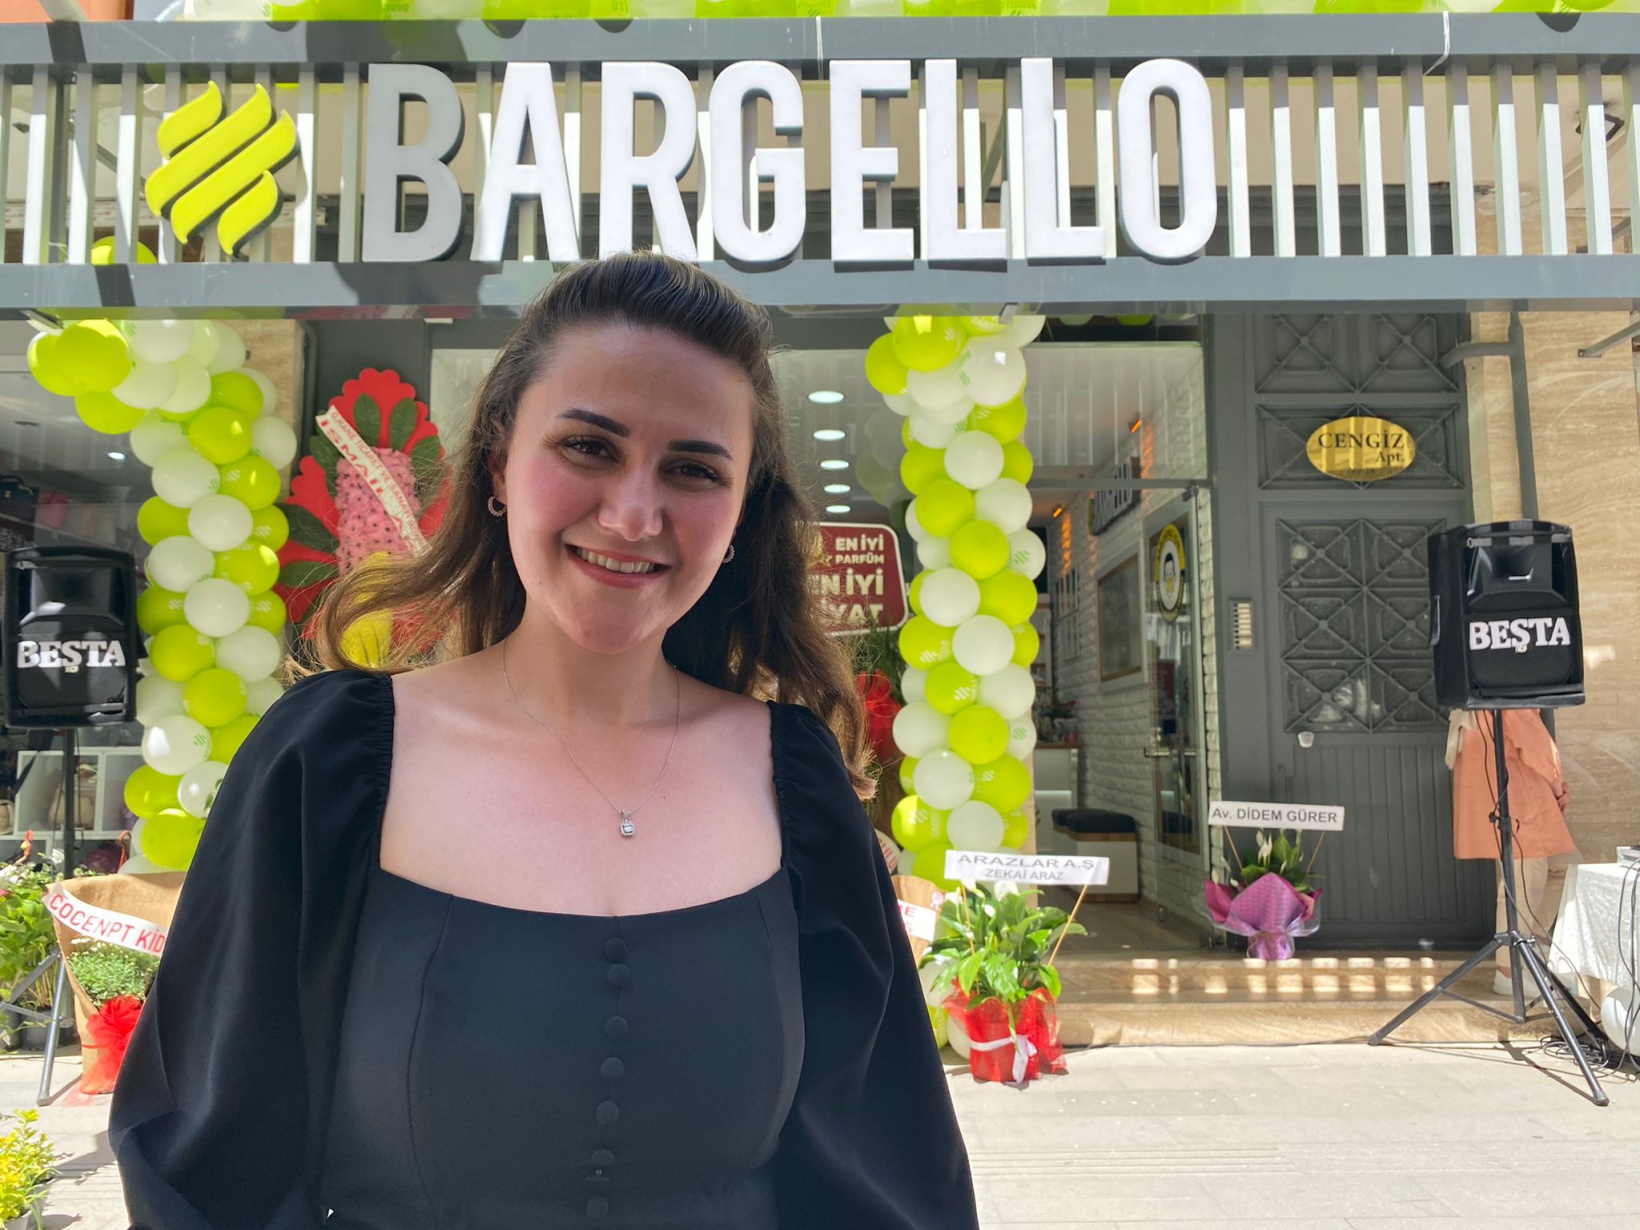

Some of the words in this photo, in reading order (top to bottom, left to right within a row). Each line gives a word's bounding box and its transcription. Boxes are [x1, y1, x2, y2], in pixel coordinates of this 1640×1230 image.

[361, 57, 1218, 263] BARGELLO
[1317, 430, 1405, 448] CENGİZ
[1376, 452, 1405, 466] Apt.
[835, 537, 858, 551] EN
[860, 534, 885, 551] İYİ
[835, 551, 885, 565] PARFÜM
[845, 568, 884, 596] İYİ
[1211, 807, 1233, 819] Av.
[1236, 806, 1282, 821] DİDEM
[1286, 808, 1338, 823] GÜRER
[957, 853, 1060, 869] ARAZLAR
[1028, 871, 1064, 881] ARAZ
[48, 892, 136, 943] COCENPT
